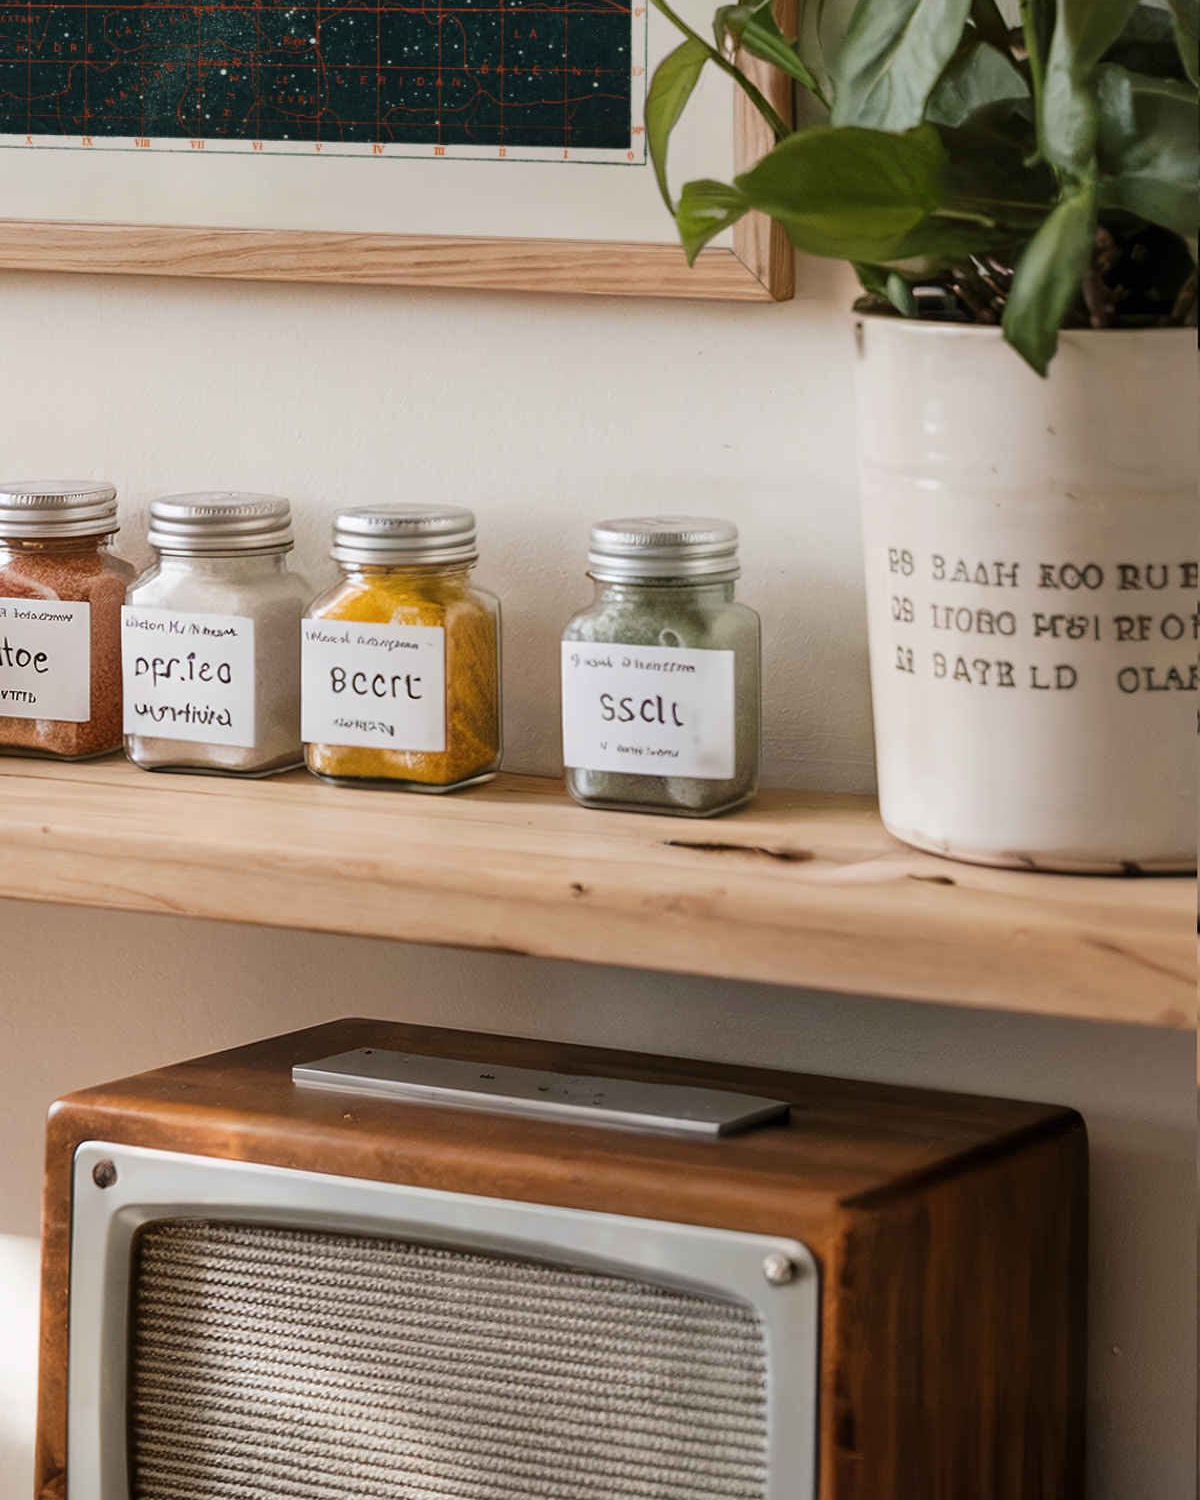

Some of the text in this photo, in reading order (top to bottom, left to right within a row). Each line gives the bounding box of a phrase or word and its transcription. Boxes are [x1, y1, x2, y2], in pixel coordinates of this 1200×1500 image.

[514, 28, 538, 39] LA
[283, 36, 306, 49] Rigel
[276, 75, 290, 84] LE
